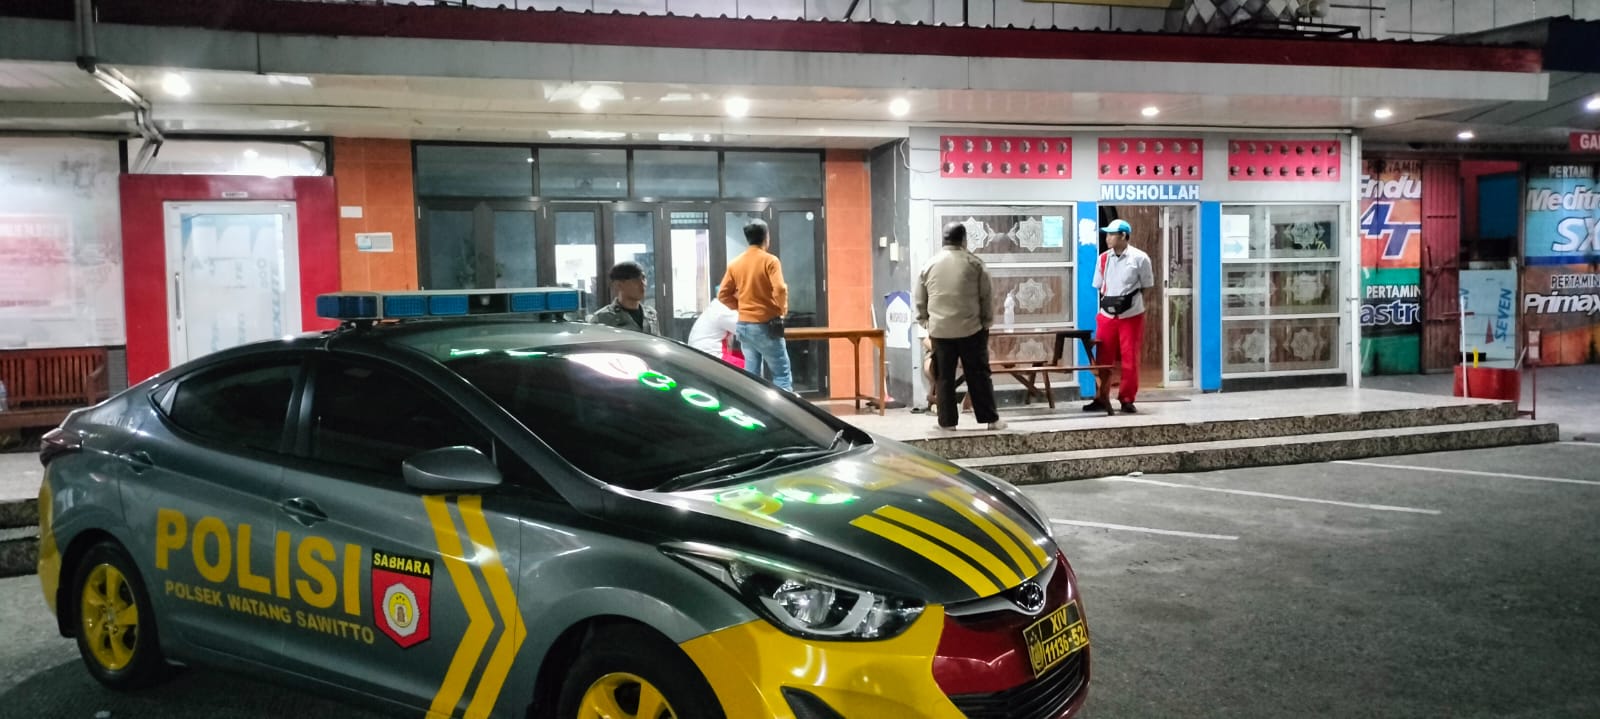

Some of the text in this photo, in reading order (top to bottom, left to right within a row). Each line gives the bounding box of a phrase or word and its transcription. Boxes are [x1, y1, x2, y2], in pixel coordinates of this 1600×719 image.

[1580, 134, 1600, 150] GA
[1101, 184, 1199, 200] MUSHOLLAH
[1495, 288, 1512, 341] SEVEN
[155, 508, 361, 616] POLISI
[373, 552, 431, 576] SABHARA
[165, 580, 374, 645] POLSEK WATANG SAWITTO
[1050, 608, 1067, 634] XIV
